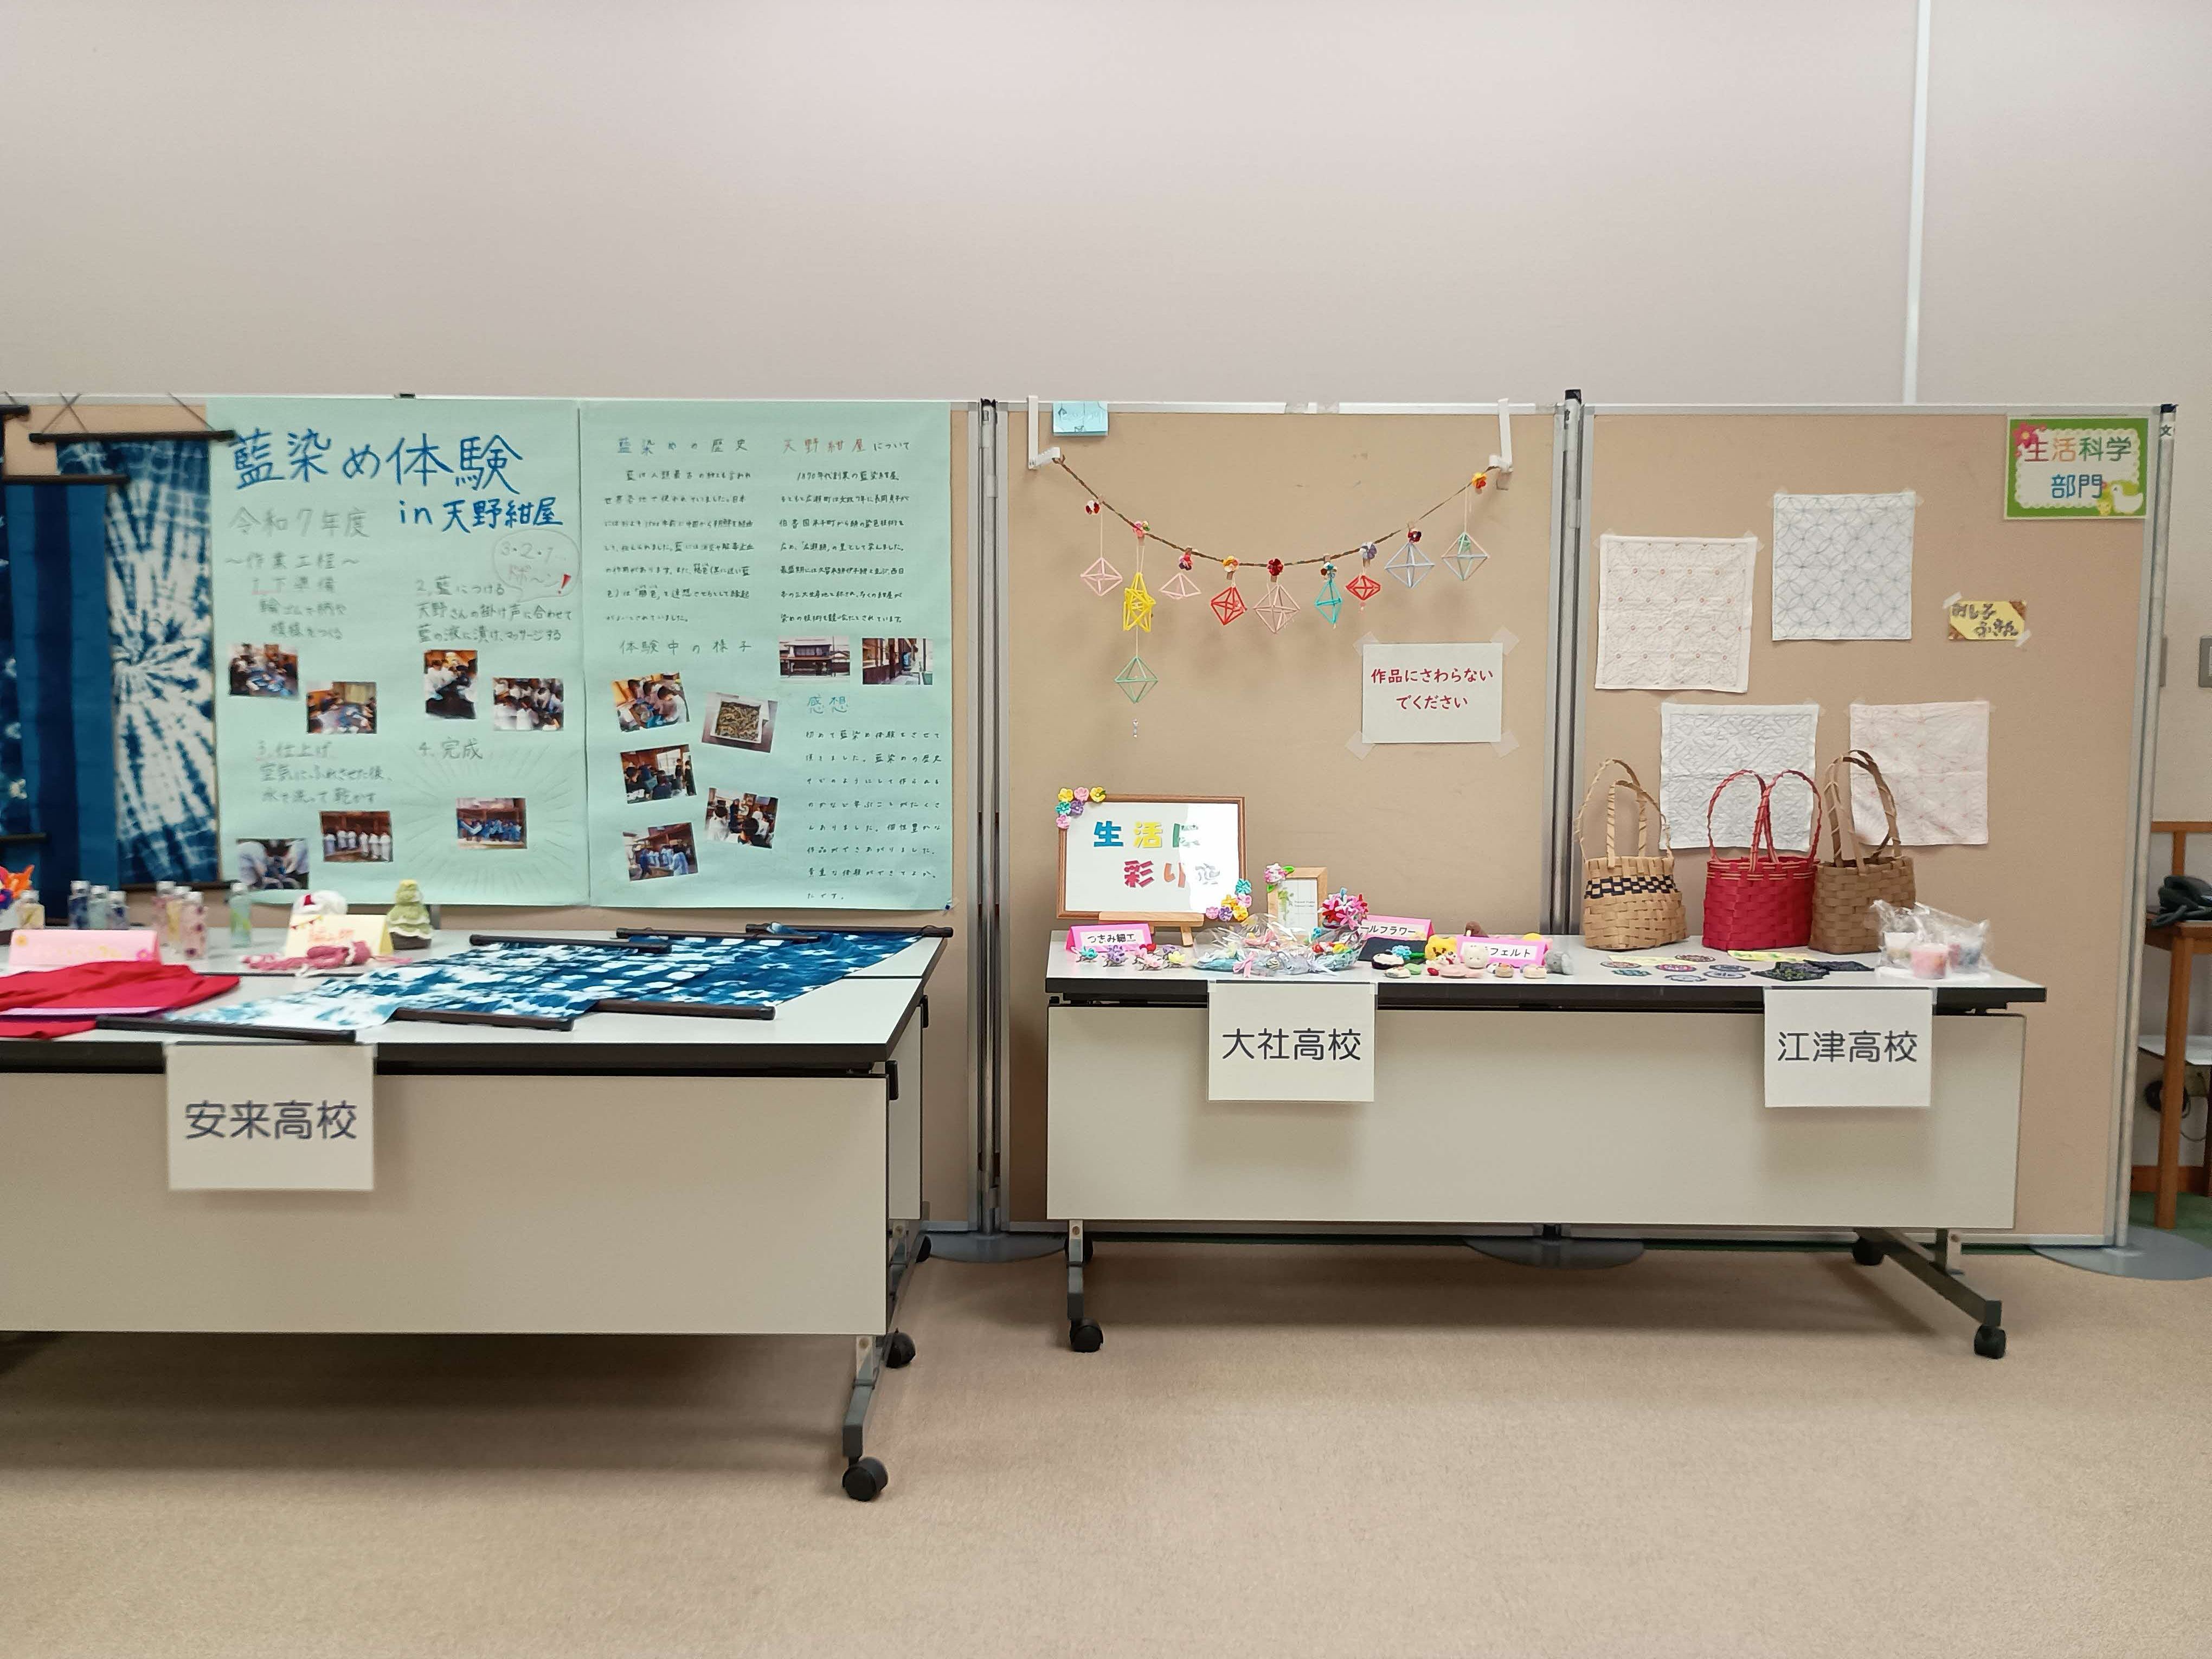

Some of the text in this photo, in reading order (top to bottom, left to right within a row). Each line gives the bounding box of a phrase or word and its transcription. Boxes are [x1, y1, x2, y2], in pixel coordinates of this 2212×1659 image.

[617, 437, 749, 455] 藍染めの歴史
[782, 437, 911, 454] 天野紺屋について
[2023, 435, 2132, 462] 生活科学
[228, 427, 524, 494] 藍染め体験
[2050, 473, 2104, 499] 部門
[227, 505, 371, 538] 令和7年度
[400, 497, 563, 533] in 天野紺屋
[619, 639, 752, 656] 体験中の様子
[1371, 668, 1494, 684] 作品にさわらない
[807, 695, 851, 715] 感想
[1396, 695, 1468, 710] でください
[1354, 924, 1416, 936] ールフラワー
[1484, 946, 1531, 957] フェルト
[1222, 1027, 1361, 1061] 大社高校
[1777, 1030, 1919, 1064] 江津高校
[184, 1099, 358, 1141] 安来高校
